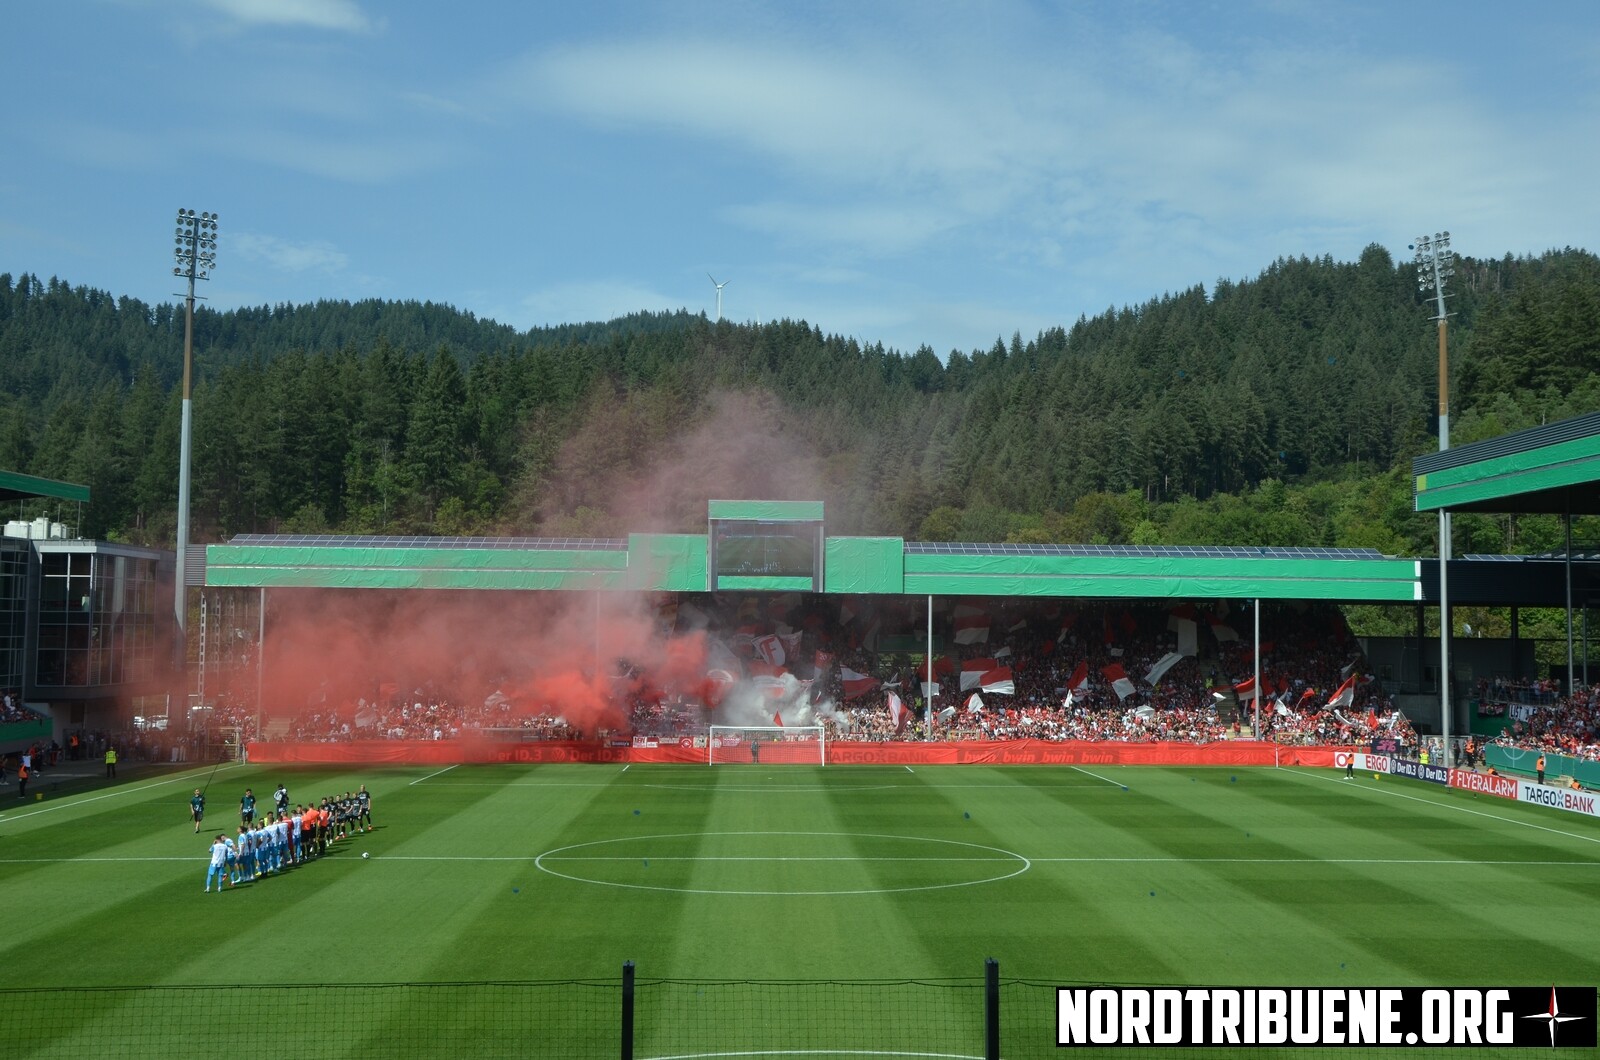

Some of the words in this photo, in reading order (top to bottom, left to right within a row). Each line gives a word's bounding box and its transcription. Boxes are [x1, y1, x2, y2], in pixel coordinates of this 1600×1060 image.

[515, 749, 542, 761] ID.3
[570, 749, 594, 761] Der
[598, 749, 625, 761] ID.3
[1003, 751, 1036, 763] bwin
[1042, 751, 1074, 763] bwin
[1081, 751, 1114, 763] bwin
[1365, 754, 1388, 772] ERGO
[1397, 762, 1406, 774] Der
[1406, 764, 1417, 776] ID.3
[1425, 767, 1435, 780] Der
[1435, 769, 1447, 782] ID.3
[1456, 772, 1516, 798] FLYERALARM
